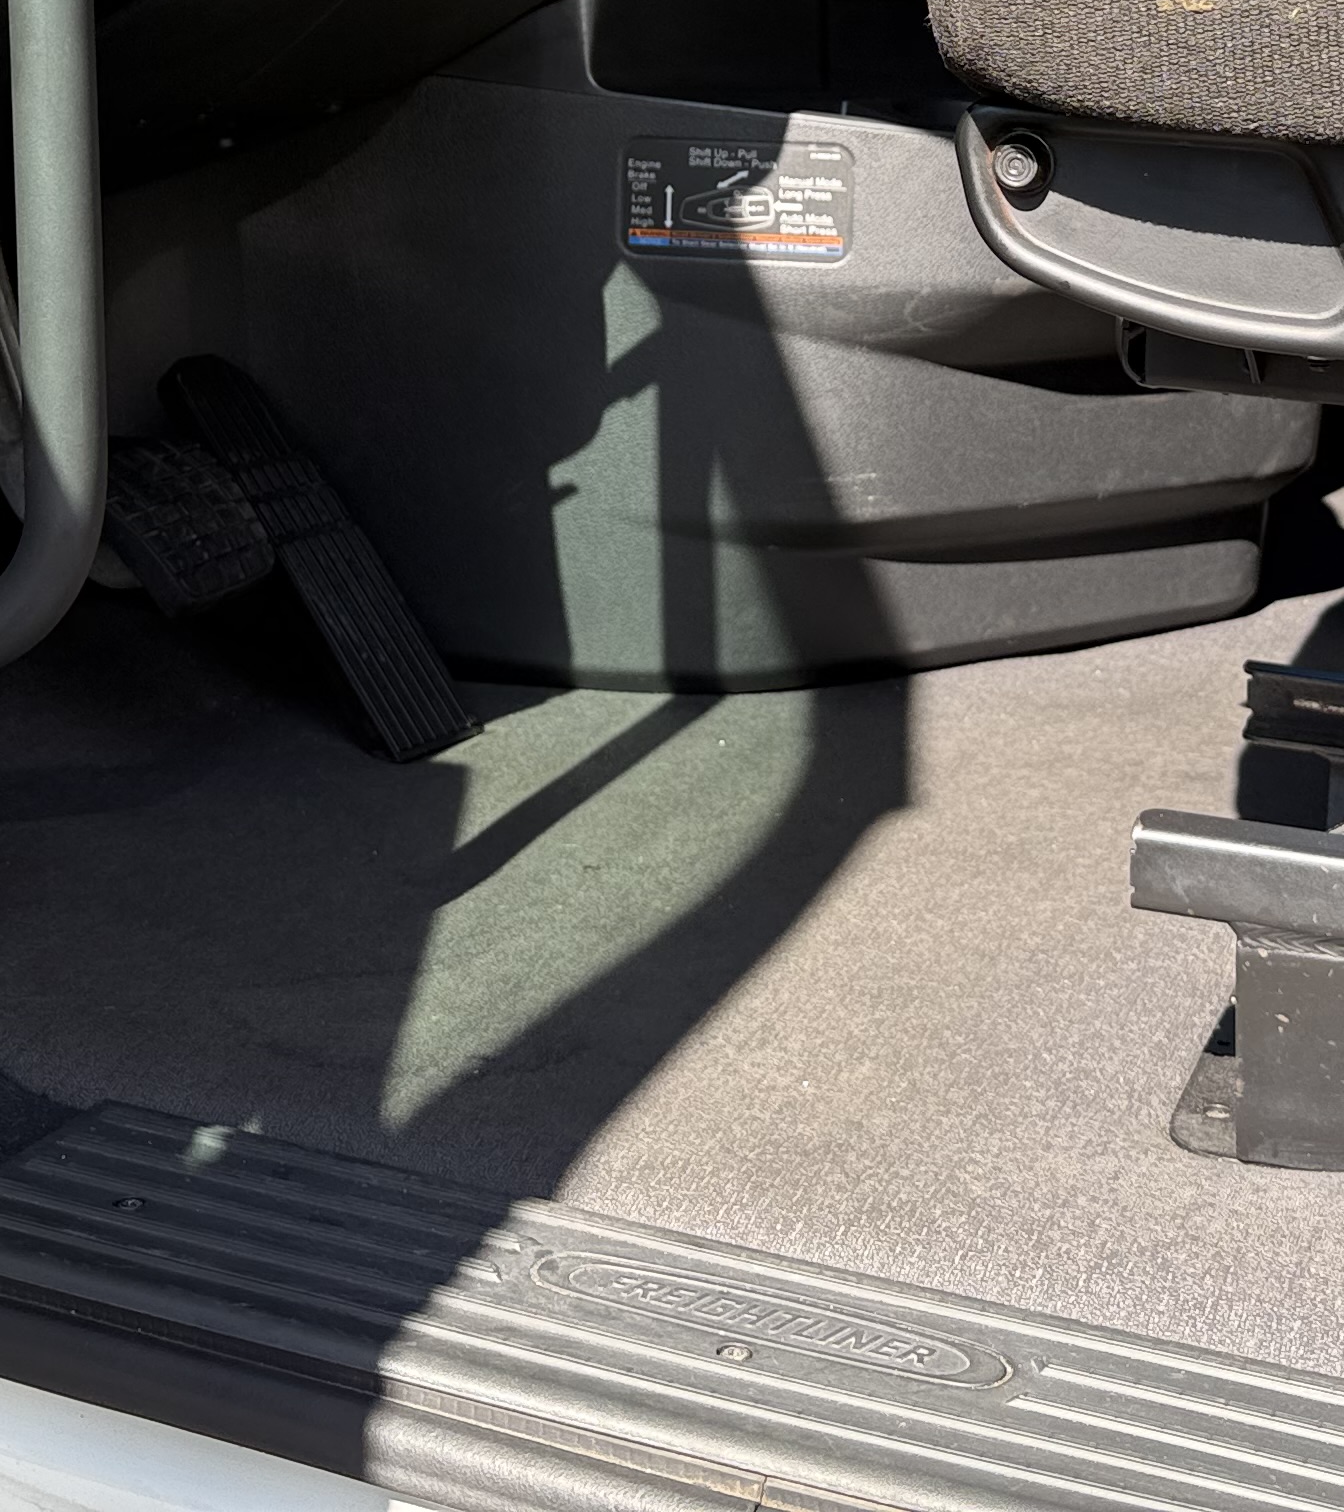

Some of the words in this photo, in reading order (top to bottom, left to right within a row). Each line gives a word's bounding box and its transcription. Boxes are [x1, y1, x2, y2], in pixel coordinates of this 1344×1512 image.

[689, 147, 711, 157] Shift
[714, 148, 728, 159] Up
[738, 149, 757, 159] Pull
[628, 157, 661, 170] Engine
[689, 156, 711, 166] Shift
[714, 157, 742, 167] Down
[752, 158, 778, 170] Push
[628, 169, 656, 179] Brake
[632, 181, 647, 191] Off
[779, 176, 814, 188] Manual
[816, 177, 843, 188] Mode
[632, 193, 651, 203] Low
[778, 188, 803, 202] Long
[804, 189, 832, 202] Press
[631, 205, 652, 215] Med
[631, 217, 654, 228] High
[780, 213, 803, 224] Auto
[805, 213, 834, 224] Mode
[780, 224, 807, 235] Short
[808, 226, 837, 237] Press
[612, 1274, 938, 1367] FREIGHTLINER
